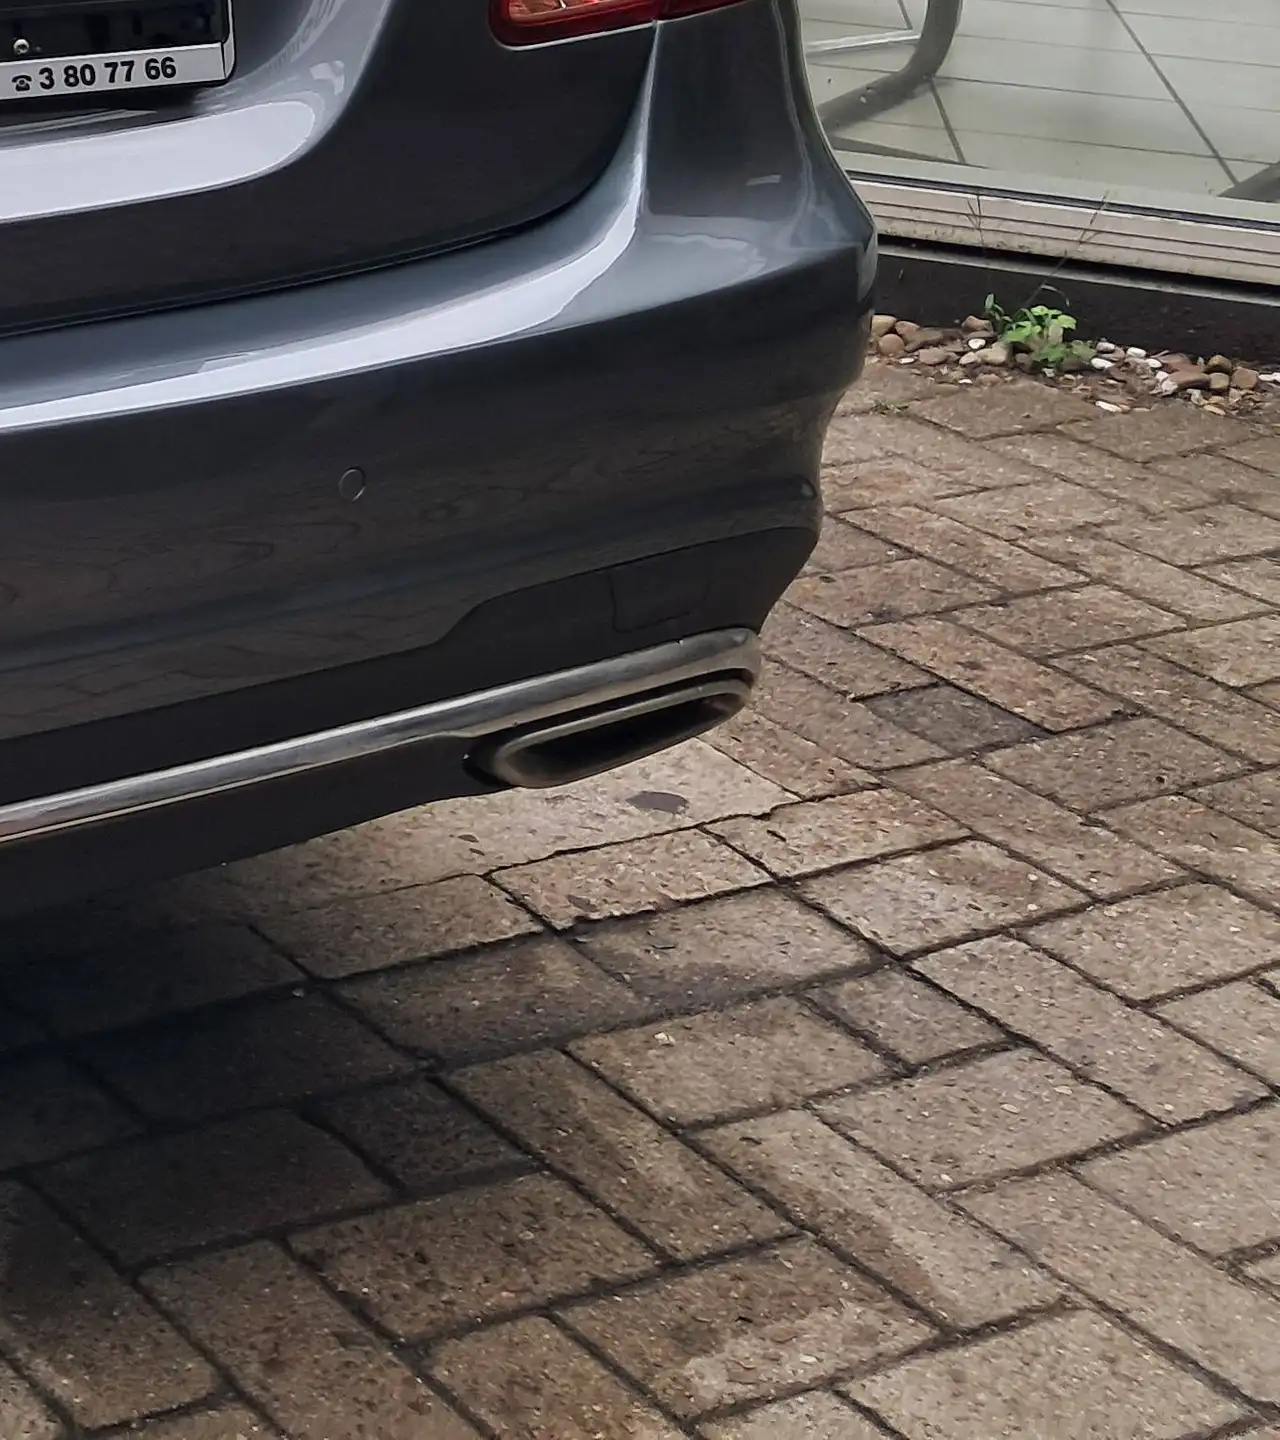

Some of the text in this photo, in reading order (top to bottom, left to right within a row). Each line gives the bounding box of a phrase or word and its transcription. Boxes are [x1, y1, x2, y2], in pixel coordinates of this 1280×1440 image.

[39, 67, 55, 90] 3
[64, 63, 97, 88] 80
[104, 60, 136, 84] 77
[144, 56, 178, 81] 66
